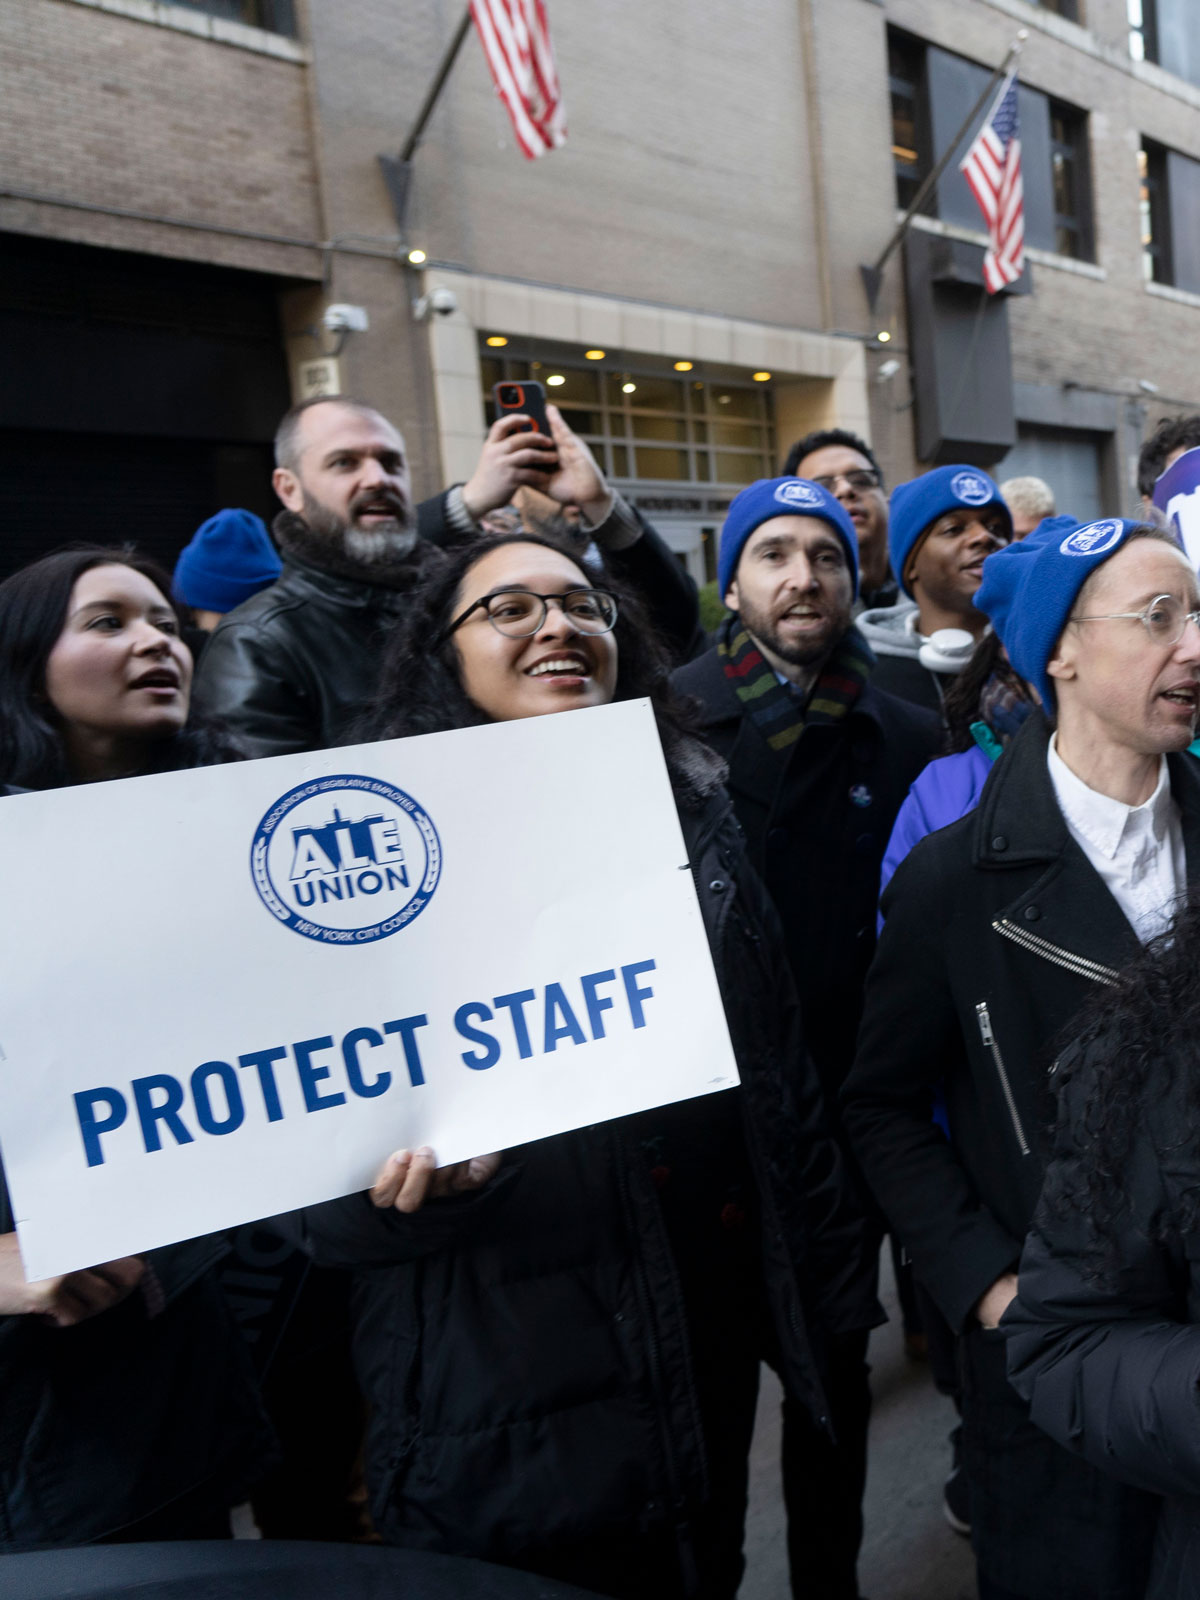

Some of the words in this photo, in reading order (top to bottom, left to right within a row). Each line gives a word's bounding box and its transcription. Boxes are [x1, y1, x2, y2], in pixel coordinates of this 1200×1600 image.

[262, 789, 307, 834] ASSOCIATION
[305, 783, 320, 796] OF
[289, 815, 406, 882] ALE
[293, 864, 411, 908] UNION
[293, 919, 323, 937] NEW
[321, 929, 356, 942] YORK
[355, 926, 382, 941] CITY
[381, 897, 427, 934] COUNCIL
[72, 1012, 428, 1168] PROTECT
[452, 958, 657, 1073] STAFF
